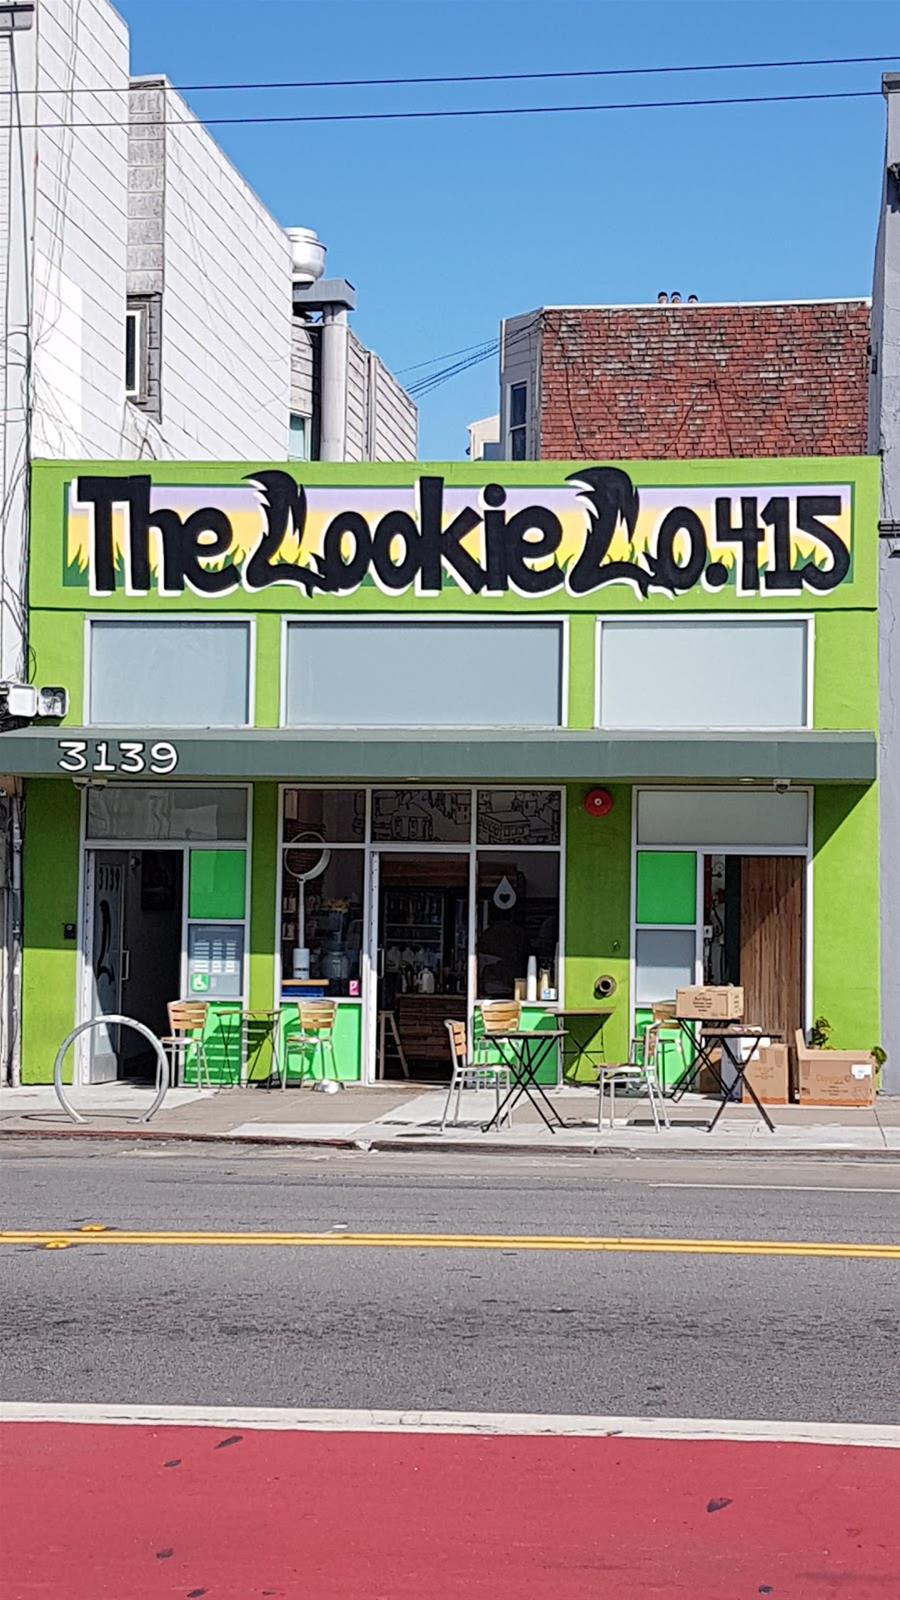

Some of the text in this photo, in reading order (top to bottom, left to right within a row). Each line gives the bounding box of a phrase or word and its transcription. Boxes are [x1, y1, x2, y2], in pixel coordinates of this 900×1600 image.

[72, 474, 240, 596] The
[58, 740, 178, 774] 3139
[98, 867, 121, 892] 3139
